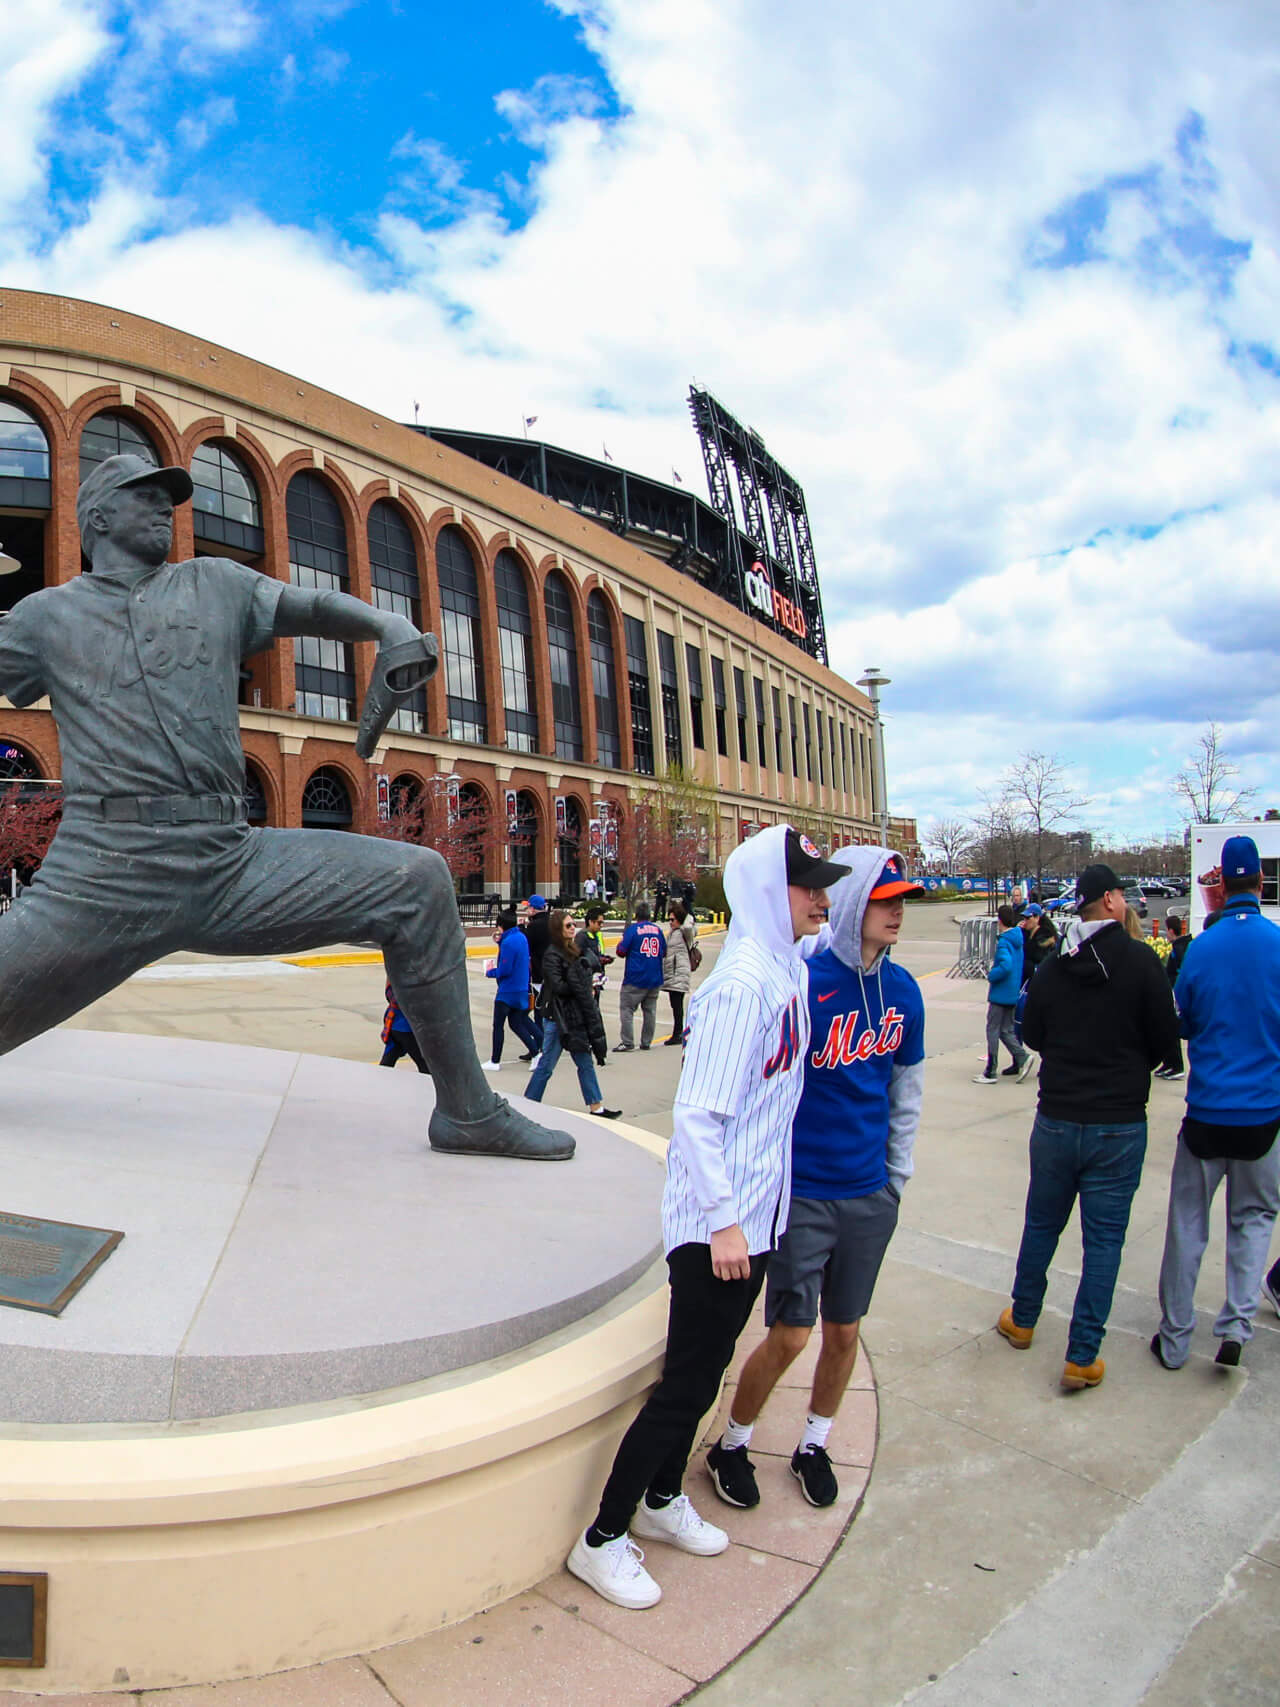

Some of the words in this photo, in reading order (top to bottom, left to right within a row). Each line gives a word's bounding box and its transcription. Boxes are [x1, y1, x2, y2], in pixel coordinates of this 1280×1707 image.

[772, 588, 807, 638] FIELD
[640, 936, 660, 958] 48
[812, 1006, 904, 1069] Mets
